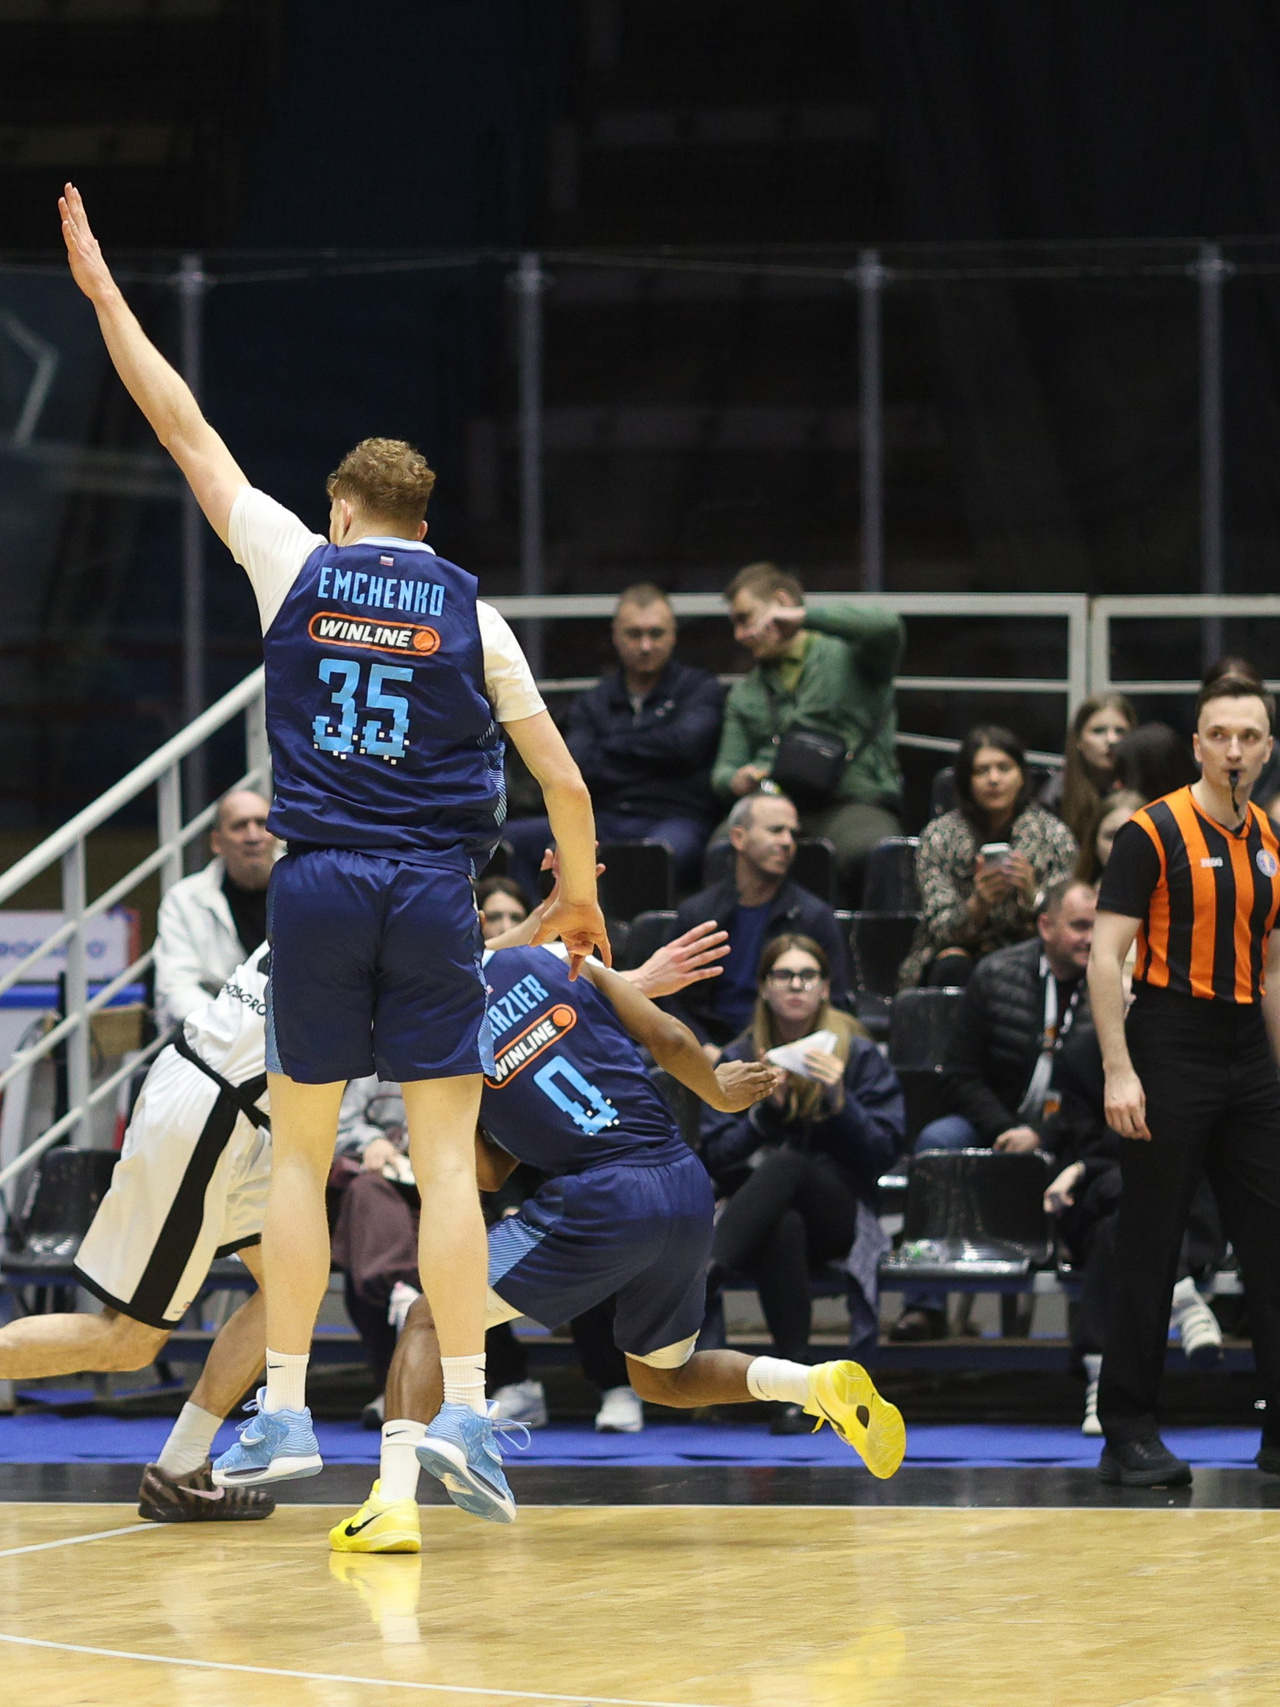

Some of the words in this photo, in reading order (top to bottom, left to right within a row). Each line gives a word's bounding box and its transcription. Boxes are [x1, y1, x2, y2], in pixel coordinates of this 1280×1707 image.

[318, 567, 446, 617] EMCHENKO
[319, 618, 412, 648] WINLINE
[312, 658, 415, 762] 35
[495, 1019, 557, 1082] WINLINE
[533, 1055, 618, 1135] 0
